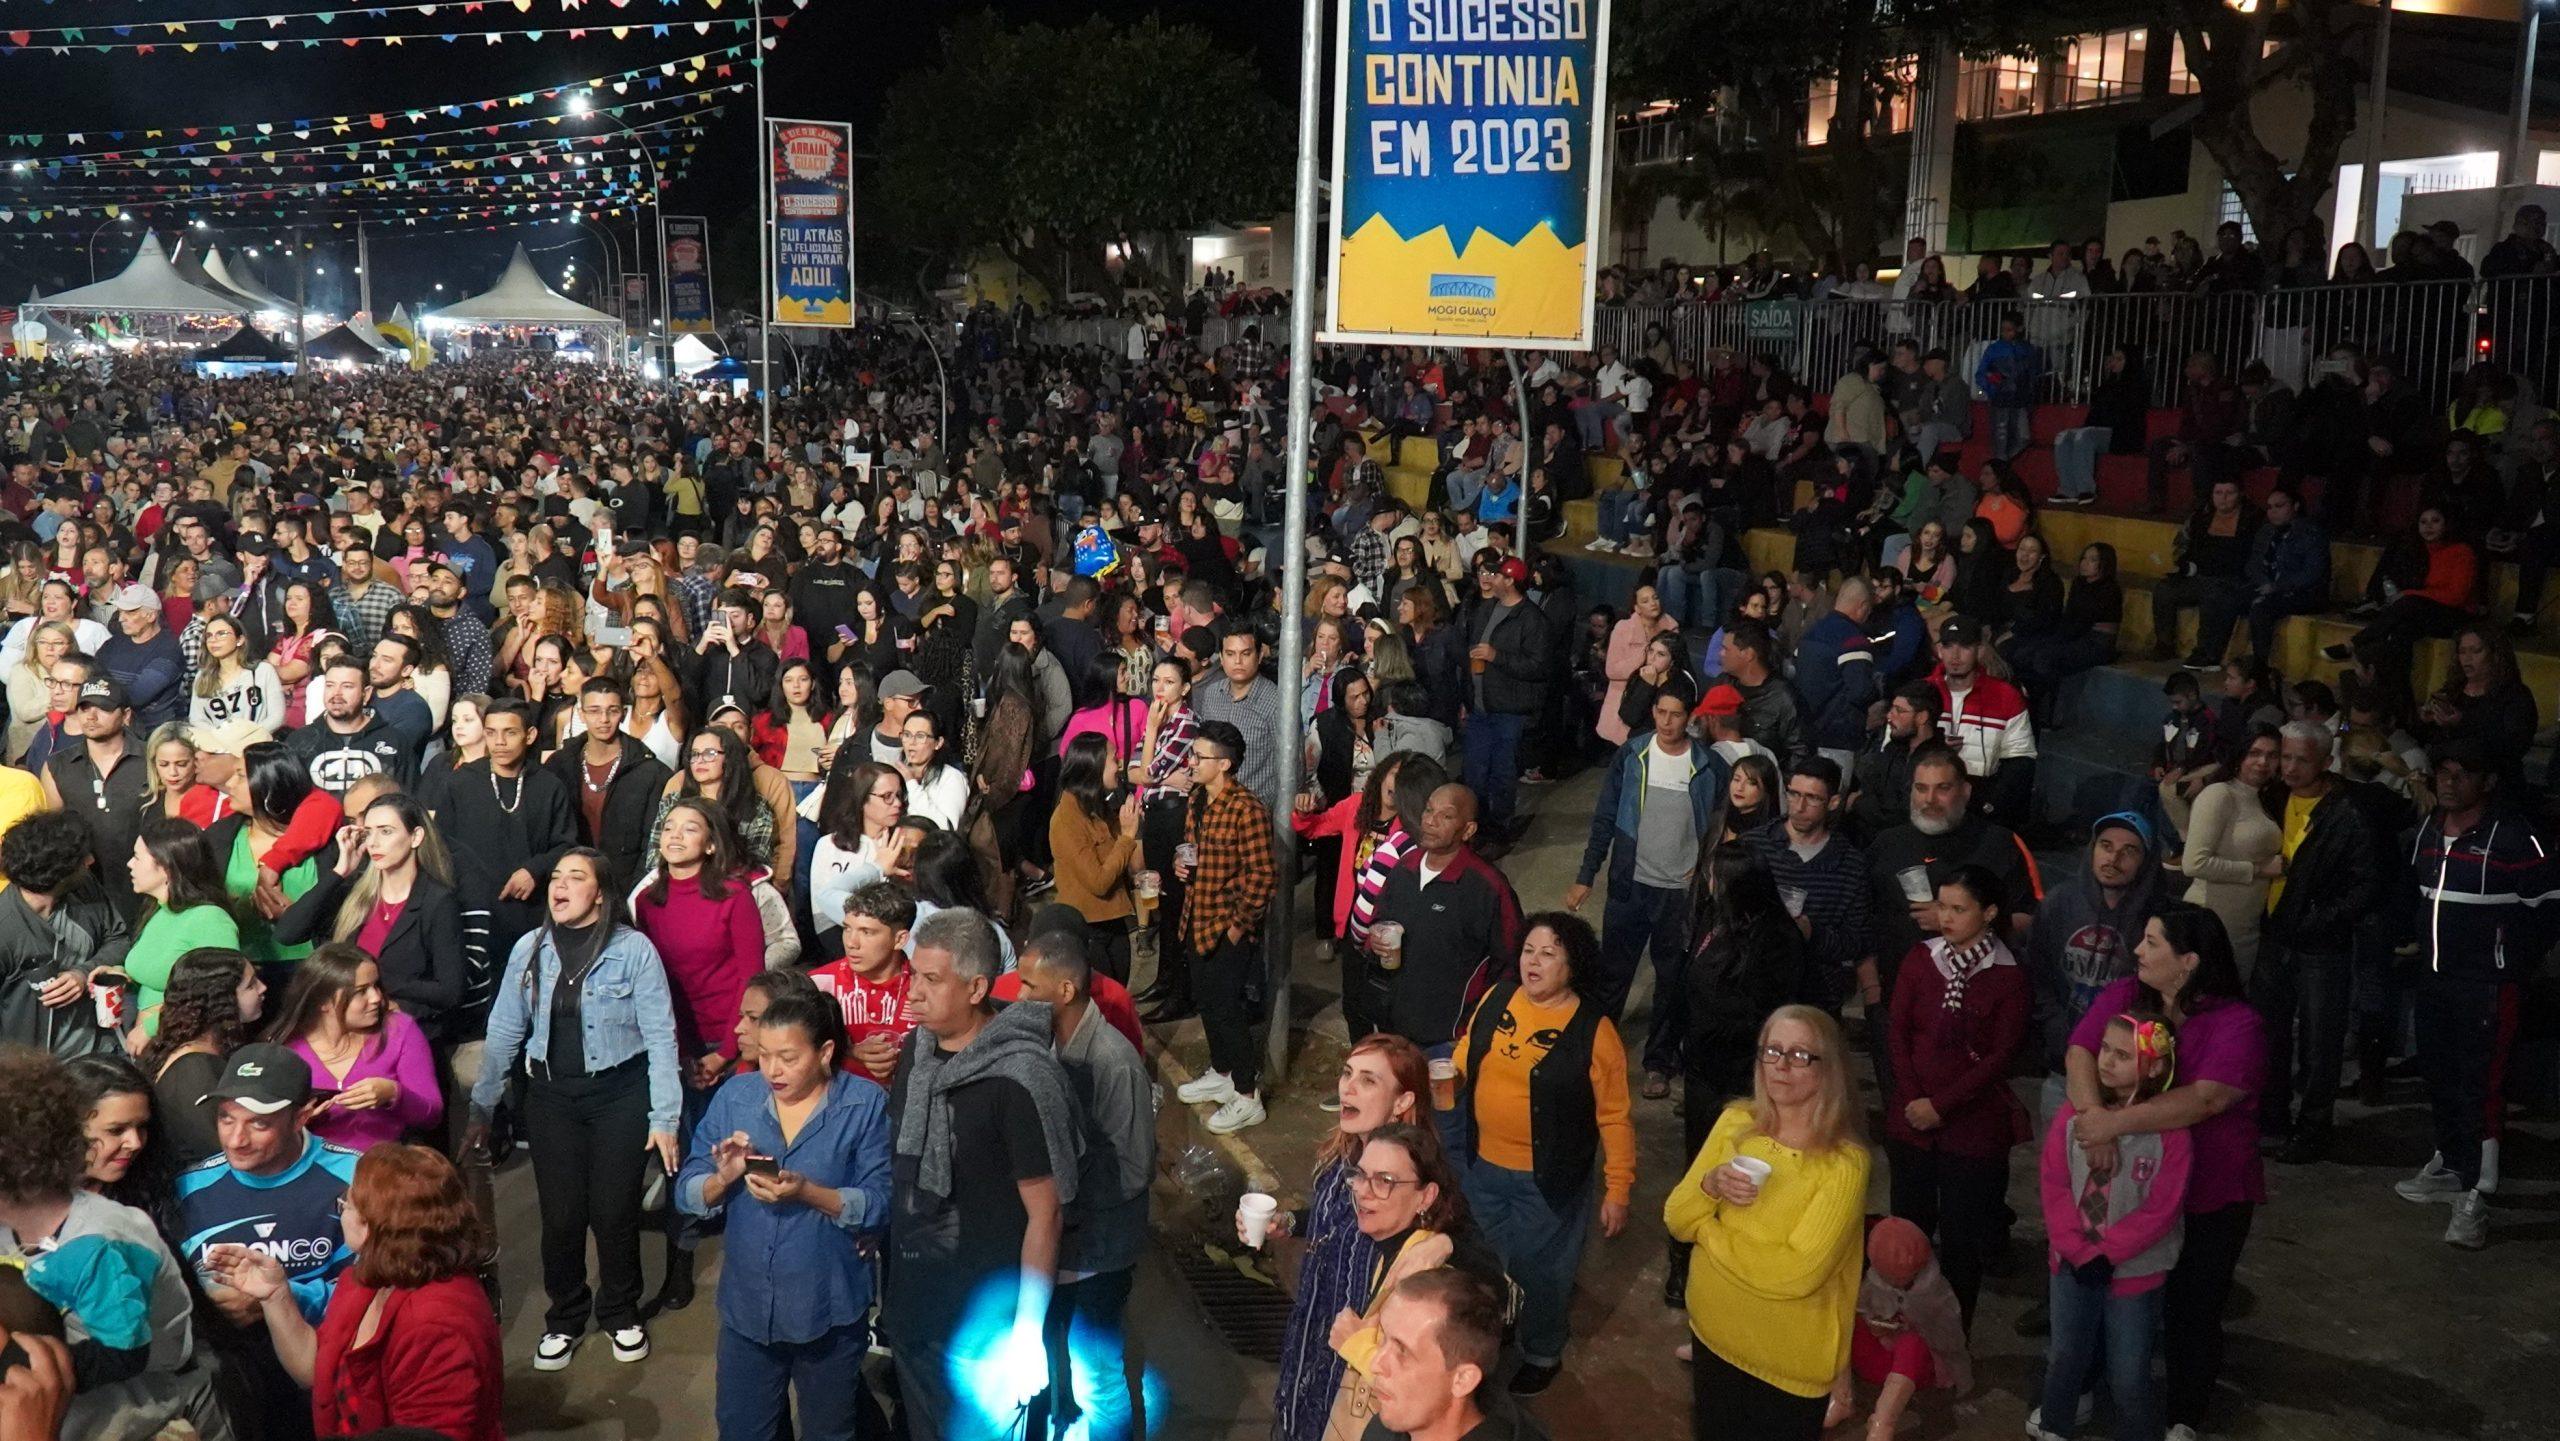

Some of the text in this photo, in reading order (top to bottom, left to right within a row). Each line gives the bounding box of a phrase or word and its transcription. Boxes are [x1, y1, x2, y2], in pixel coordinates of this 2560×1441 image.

[1368, 0, 1587, 41] O SUCESSO
[1366, 54, 1580, 106] CONTINUA
[1371, 118, 1571, 177] EM 2023
[794, 195, 837, 207] SUCESSO
[780, 226, 842, 242] FUI ATRÁS
[781, 243, 843, 253] DA FELICIDADE
[781, 253, 844, 265] E VIM PARAR
[791, 267, 836, 287] AQUI.
[1428, 305, 1496, 318] MOGI GUAÇU
[1751, 304, 1792, 327] SAÍDA
